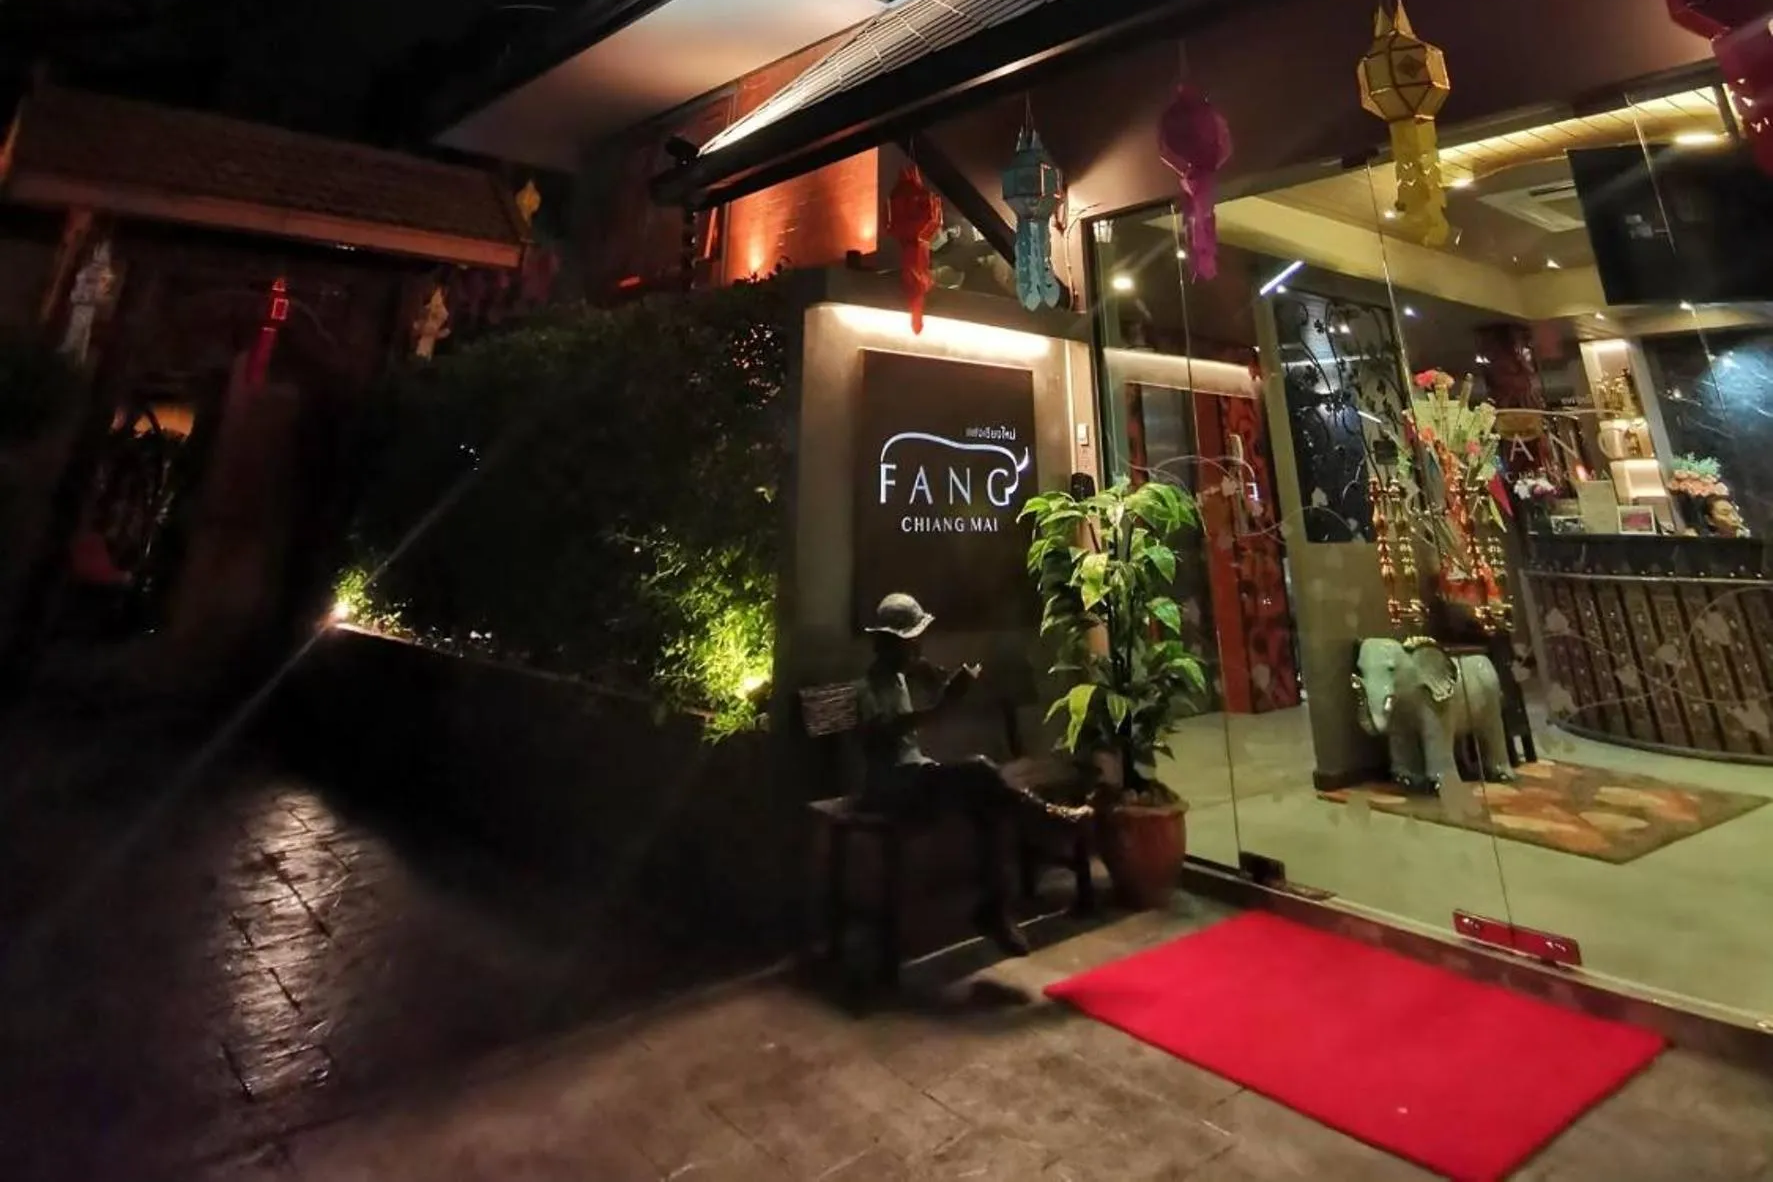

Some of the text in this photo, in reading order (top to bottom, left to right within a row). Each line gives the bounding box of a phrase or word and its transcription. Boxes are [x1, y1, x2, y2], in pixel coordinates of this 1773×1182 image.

[880, 463, 1019, 507] FANG
[901, 517, 999, 533] CHIANG MAI
